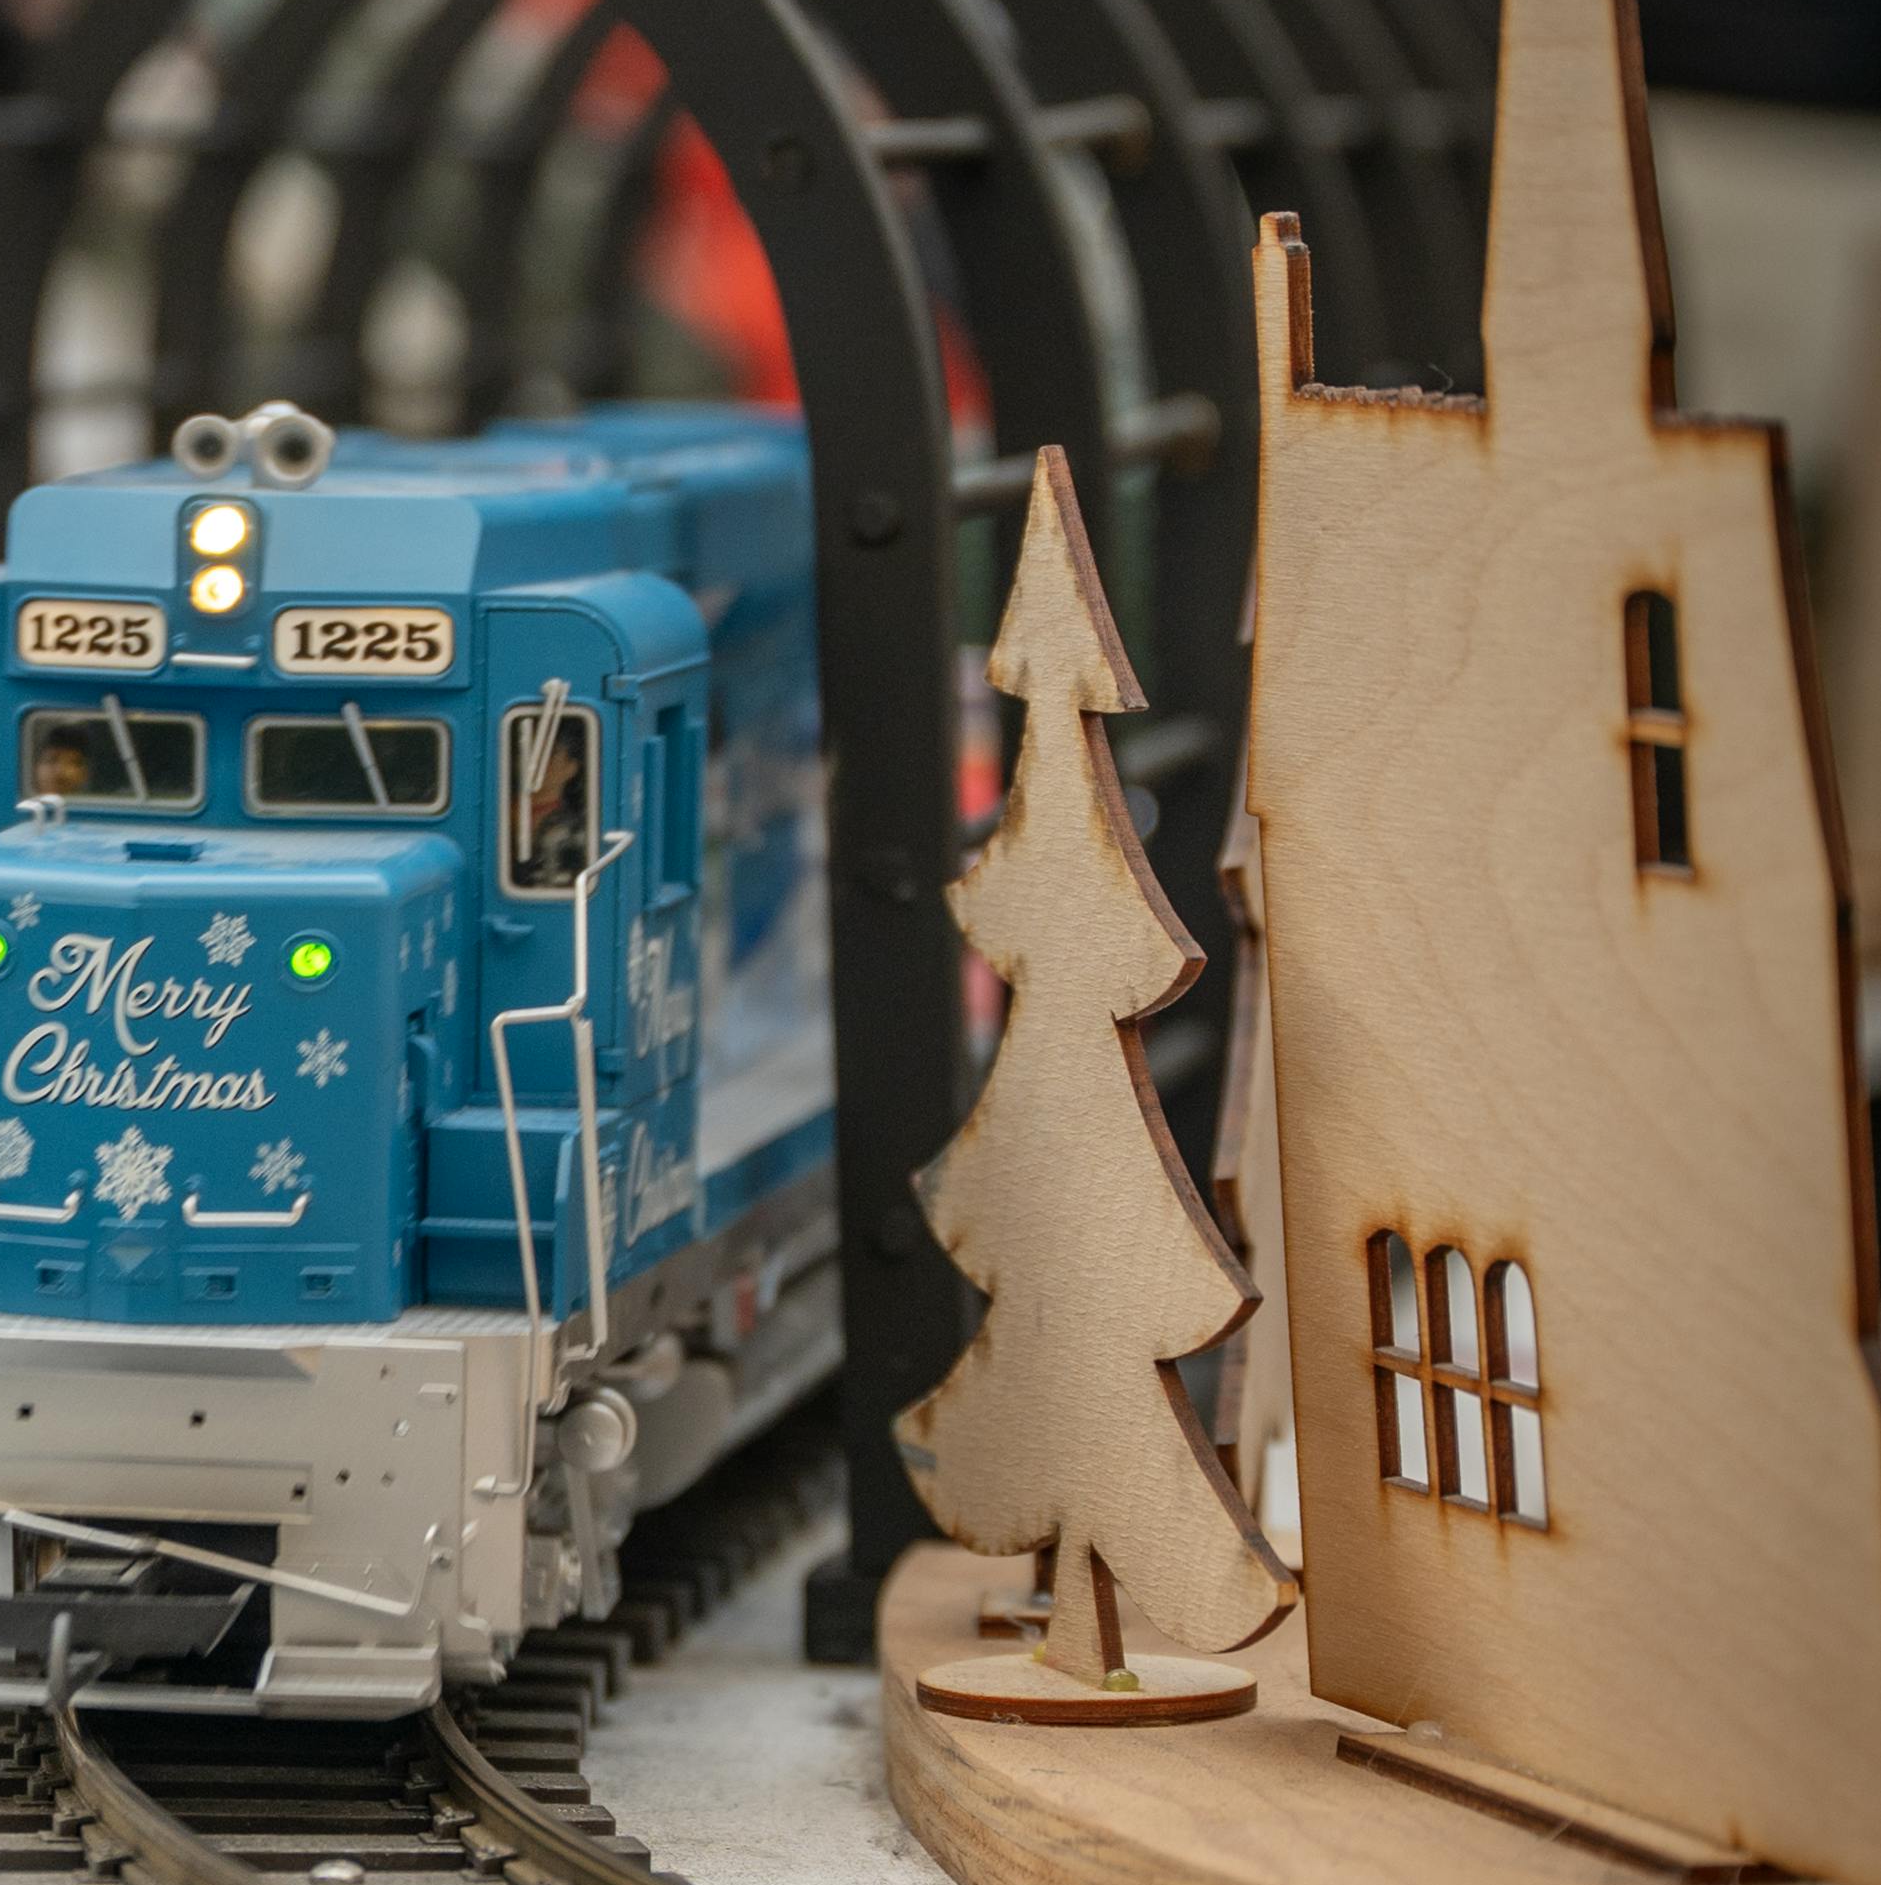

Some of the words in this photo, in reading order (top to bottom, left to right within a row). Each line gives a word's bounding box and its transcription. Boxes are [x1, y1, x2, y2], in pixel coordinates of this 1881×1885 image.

[29, 613, 153, 657] 1225
[291, 619, 443, 663] 1225
[27, 932, 253, 1057] Merry
[0, 1020, 279, 1112] Christmas
